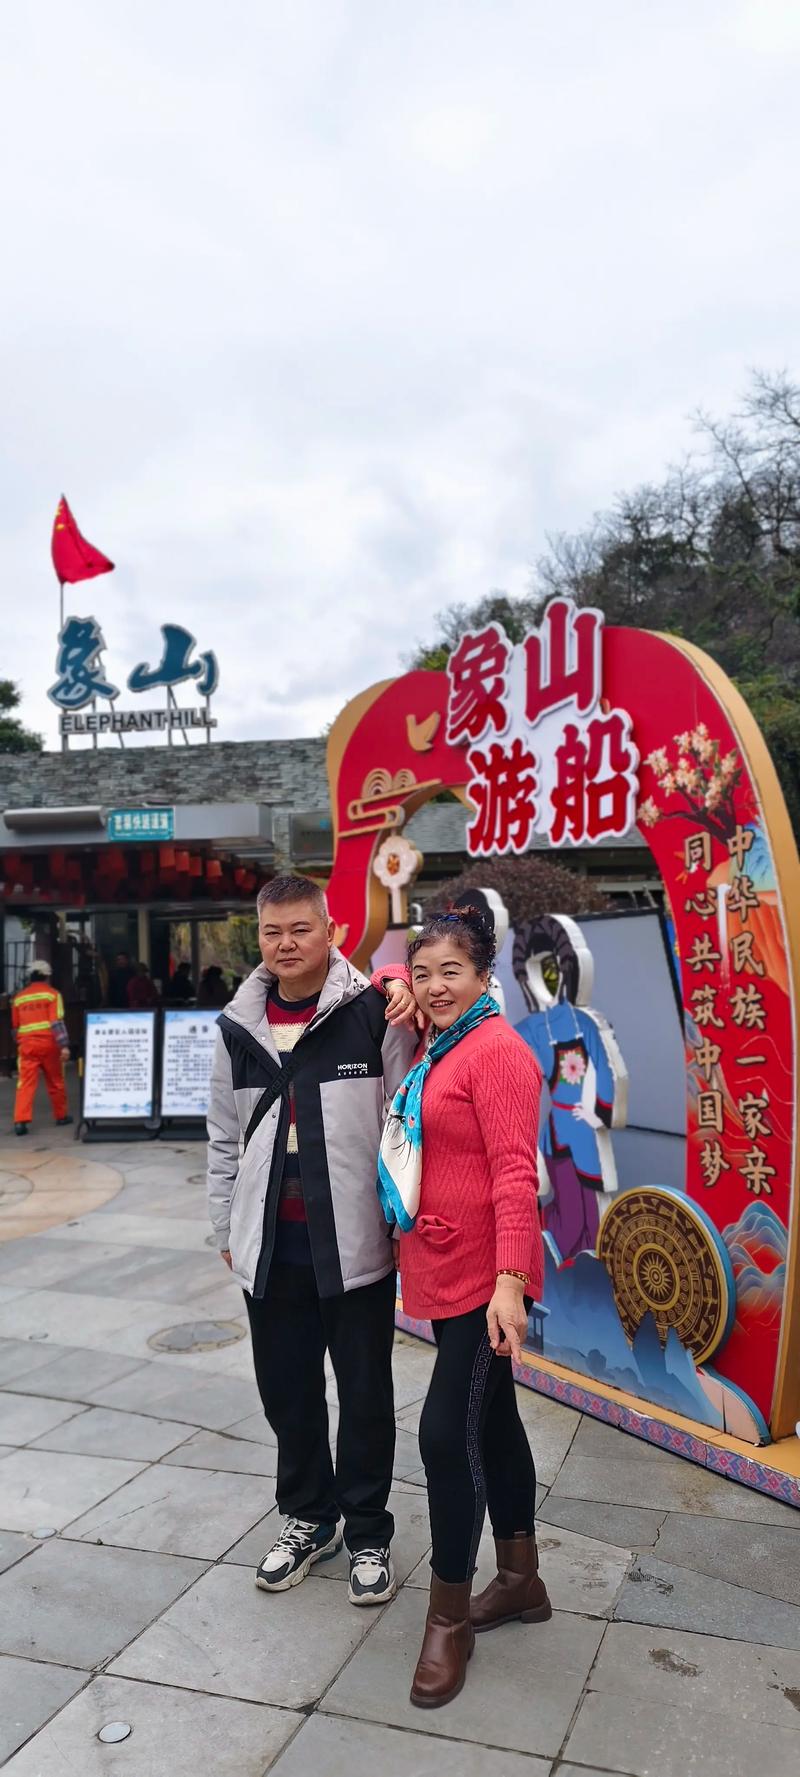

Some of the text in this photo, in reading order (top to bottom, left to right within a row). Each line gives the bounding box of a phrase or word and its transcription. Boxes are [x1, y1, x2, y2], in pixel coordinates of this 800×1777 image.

[48, 616, 219, 710] 象山
[60, 708, 216, 734] ELEPHANT HILL
[448, 599, 603, 744] 象山
[466, 710, 638, 856] 游船
[337, 1062, 368, 1071] HORIZON
[683, 830, 731, 1188] 同心共筑中国梦
[727, 824, 777, 1197] 中华民族一家亲
